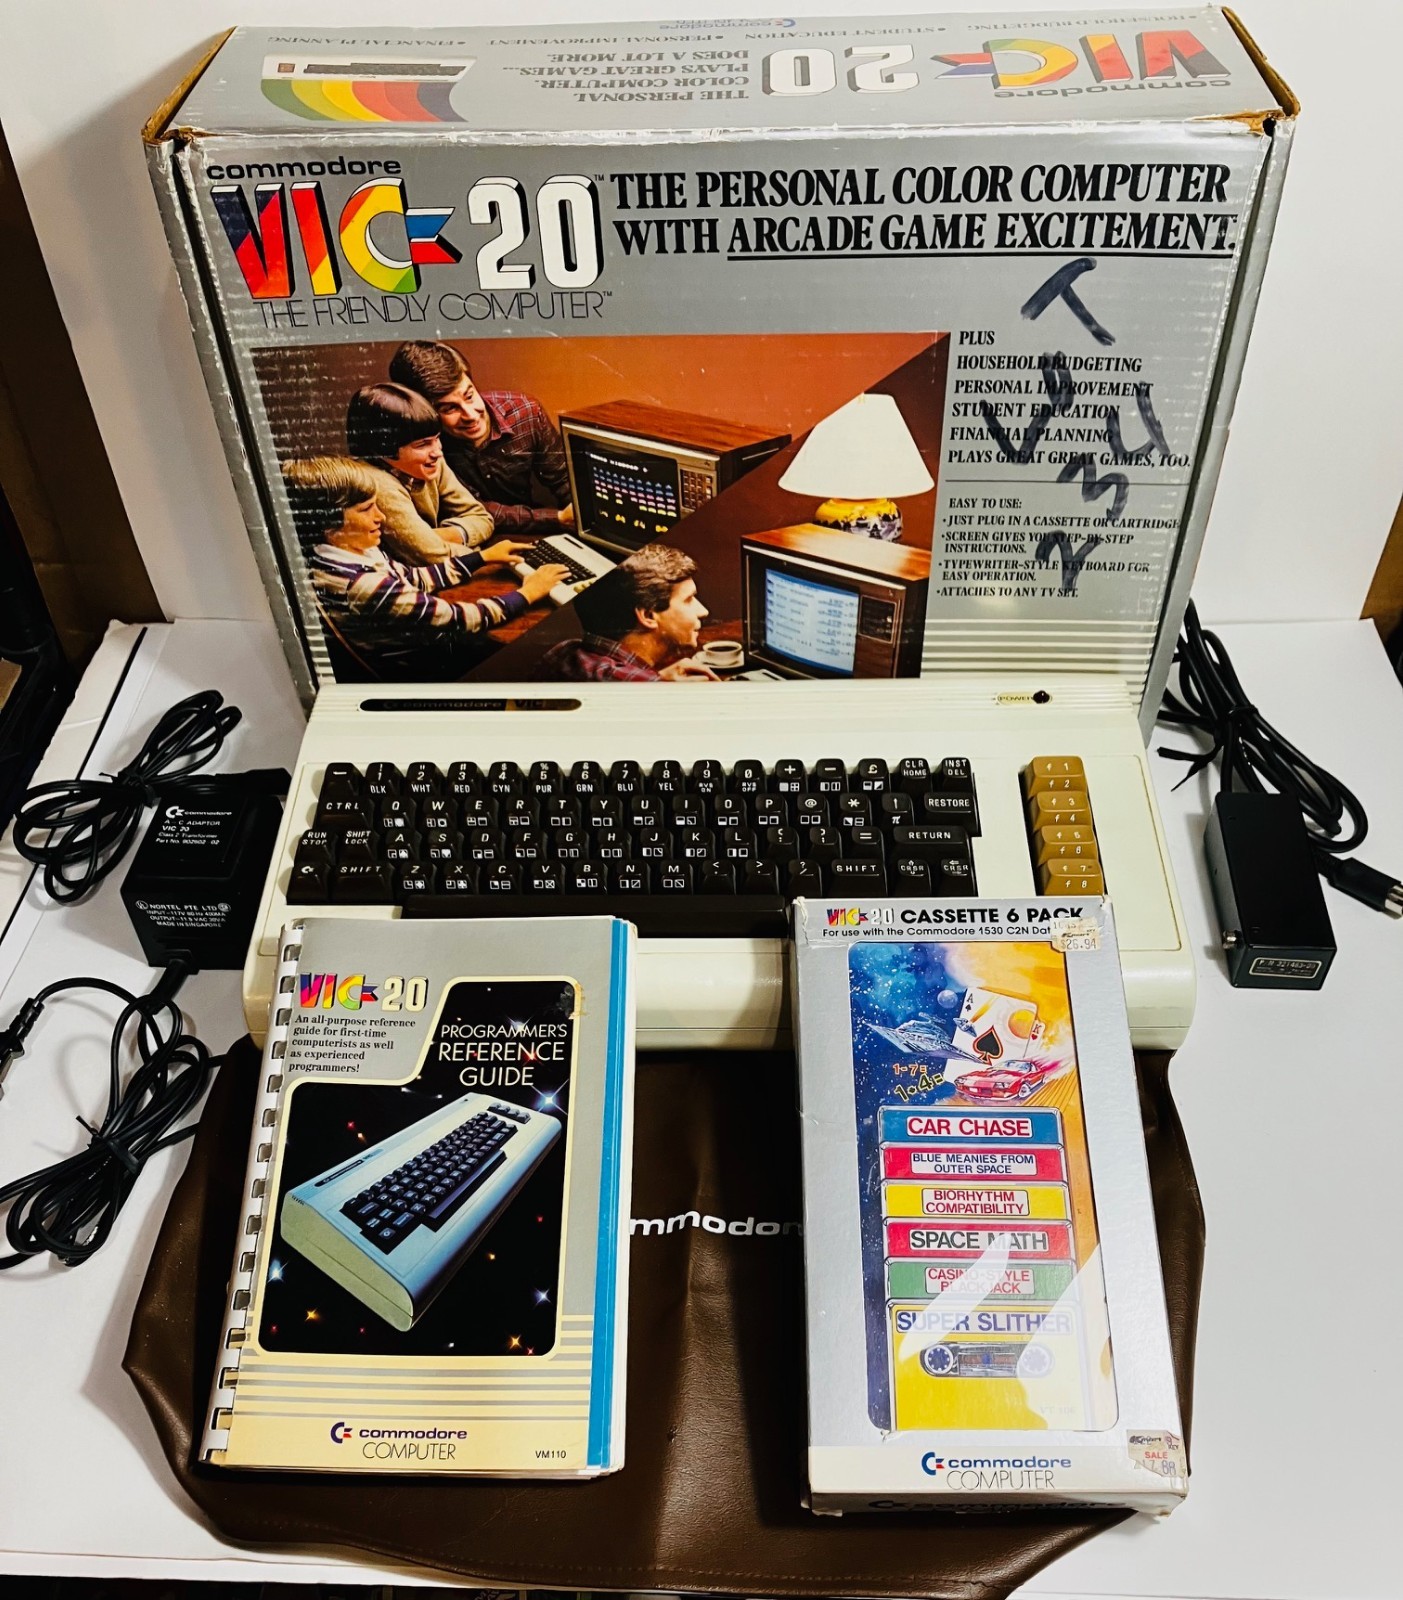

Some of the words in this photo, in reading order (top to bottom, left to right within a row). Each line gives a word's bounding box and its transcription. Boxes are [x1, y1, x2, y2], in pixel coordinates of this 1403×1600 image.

[268, 36, 357, 45] PLANNING
[360, 37, 457, 46] FINANCIAL
[489, 36, 617, 46] IMPROVEMENT
[627, 34, 712, 43] PERSONAL
[547, 52, 616, 62] MORE.
[624, 52, 664, 61] LOT
[672, 51, 686, 60] A
[692, 50, 749, 60] DOES
[602, 64, 676, 75] GREAT
[681, 63, 749, 73] PLAYS
[534, 77, 668, 89] COMPUTER.
[674, 76, 749, 87] COLOR
[994, 79, 1231, 98] commodore
[574, 90, 694, 102] PERSONAL
[700, 89, 749, 100] THE
[206, 156, 401, 179] commodore
[610, 172, 687, 209] THE
[696, 168, 885, 208] PERSONAL
[893, 165, 1013, 204] COLOR
[1021, 163, 1231, 203] COMPUTER
[612, 218, 720, 256] WITH
[727, 215, 874, 253] ARCADE
[879, 213, 987, 251] GAME
[994, 211, 1238, 251] EXCITEMENT.
[253, 299, 308, 328] THE
[313, 295, 430, 326] FRIENDLY
[439, 291, 604, 321] COMPUTER
[959, 331, 995, 345] PLUS
[957, 355, 1047, 370] HOUSEHOLD
[1051, 355, 1143, 372] BUDGETING
[954, 380, 1033, 394] PERSONAL
[1037, 380, 1153, 397] IMPROVEMENT
[952, 402, 1026, 418] STUDENT
[1030, 402, 1120, 419] EDUCATION
[950, 427, 1032, 441] FINANCIAL
[1038, 427, 1113, 443] PLANNING
[948, 450, 992, 463] PLAYS
[996, 450, 1045, 464] GREAT
[1048, 451, 1097, 465] GREAT
[1100, 452, 1155, 468] GAMES,
[1159, 454, 1191, 467] TOO.
[949, 498, 978, 509] EASY
[981, 498, 996, 508] TO
[999, 498, 1022, 509] USE:
[947, 515, 975, 527] JUST
[977, 515, 1005, 526] PLUG
[1008, 515, 1021, 526] IN
[1023, 516, 1031, 526] A
[1033, 516, 1091, 527] CASSETTE
[1093, 517, 1109, 528] OR
[945, 531, 989, 542] SCREEN
[992, 531, 1025, 542] GIVES
[945, 543, 1027, 554] INSTRUCTIONS.
[943, 559, 1059, 571] TYPEWRITER-STYLE
[1062, 560, 1125, 572] KEYBOARD
[1127, 562, 1150, 573] FOR
[942, 571, 970, 581] EASY
[972, 571, 1037, 582] OPERATION.
[941, 586, 996, 597] ATTACHES
[998, 587, 1012, 597] TO
[1014, 587, 1038, 597] ANY
[1040, 587, 1056, 597] TV
[1057, 588, 1079, 598] SET.
[403, 700, 502, 708] commodore
[905, 759, 924, 769] CLR
[945, 759, 967, 769] INST
[903, 768, 927, 777] HOME
[370, 784, 386, 794] BLK
[411, 784, 431, 793] WHT
[454, 784, 470, 793] RED
[493, 784, 511, 793] CYN
[536, 784, 552, 793] PUR
[576, 783, 594, 793] GRN
[617, 783, 634, 792] BLU
[658, 782, 674, 791] YEL
[326, 802, 360, 811] CTRL
[928, 798, 970, 807] RESTORE
[307, 831, 327, 839] RUN
[346, 831, 371, 839] SHIFT
[908, 831, 951, 840] RETURN
[836, 864, 877, 872] SHIFT
[900, 907, 999, 925] CASSETTE
[1006, 907, 1020, 923] 6
[1026, 907, 1084, 923] PACK
[823, 928, 839, 937] For
[841, 929, 860, 937] use
[862, 927, 884, 937] with
[886, 927, 904, 937] the
[906, 925, 976, 936] Commodore
[978, 925, 1004, 935] 1530
[1006, 925, 1029, 935] C2N
[1060, 938, 1096, 950] $26.94
[295, 1014, 309, 1024] An
[311, 1015, 367, 1027] all-purpose
[369, 1018, 416, 1028] reference
[293, 1026, 320, 1036] guide
[323, 1027, 338, 1036] for
[340, 1027, 387, 1039] first-time
[441, 1023, 567, 1039] PROGRAMMER'S
[292, 1038, 357, 1050] computerists
[359, 1041, 371, 1049] as
[373, 1041, 394, 1050] well
[304, 1051, 365, 1061] experienced
[438, 1041, 565, 1061] REFERENCE
[288, 1063, 360, 1073] programmers!
[459, 1066, 535, 1086] GUIDE
[908, 1117, 950, 1135] CAR
[959, 1118, 1030, 1136] CHASE
[912, 1153, 941, 1163] BLUE
[946, 1153, 997, 1164] MEANIES
[1001, 1154, 1034, 1164] FROM
[934, 1164, 973, 1174] OUTER
[976, 1164, 1012, 1174] SPACE
[934, 1190, 1015, 1202] BIORHYTHM
[925, 1202, 1024, 1214] COMPATIBILITY
[629, 1210, 803, 1236] mmodor
[910, 1230, 980, 1249] SPACE
[988, 1232, 1047, 1250] MATH
[928, 1268, 1030, 1282] CASINO-STYLE
[940, 1281, 1021, 1294] BLACKJACK
[897, 1311, 970, 1331] SUPER
[977, 1312, 1071, 1332] SLITHER
[359, 1428, 468, 1440] commodore
[362, 1441, 456, 1460] COMPUTER
[535, 1450, 567, 1459] VM110
[1144, 1451, 1168, 1459] SALE
[948, 1456, 1071, 1469] commodore
[946, 1470, 1055, 1491] COMPUTER
